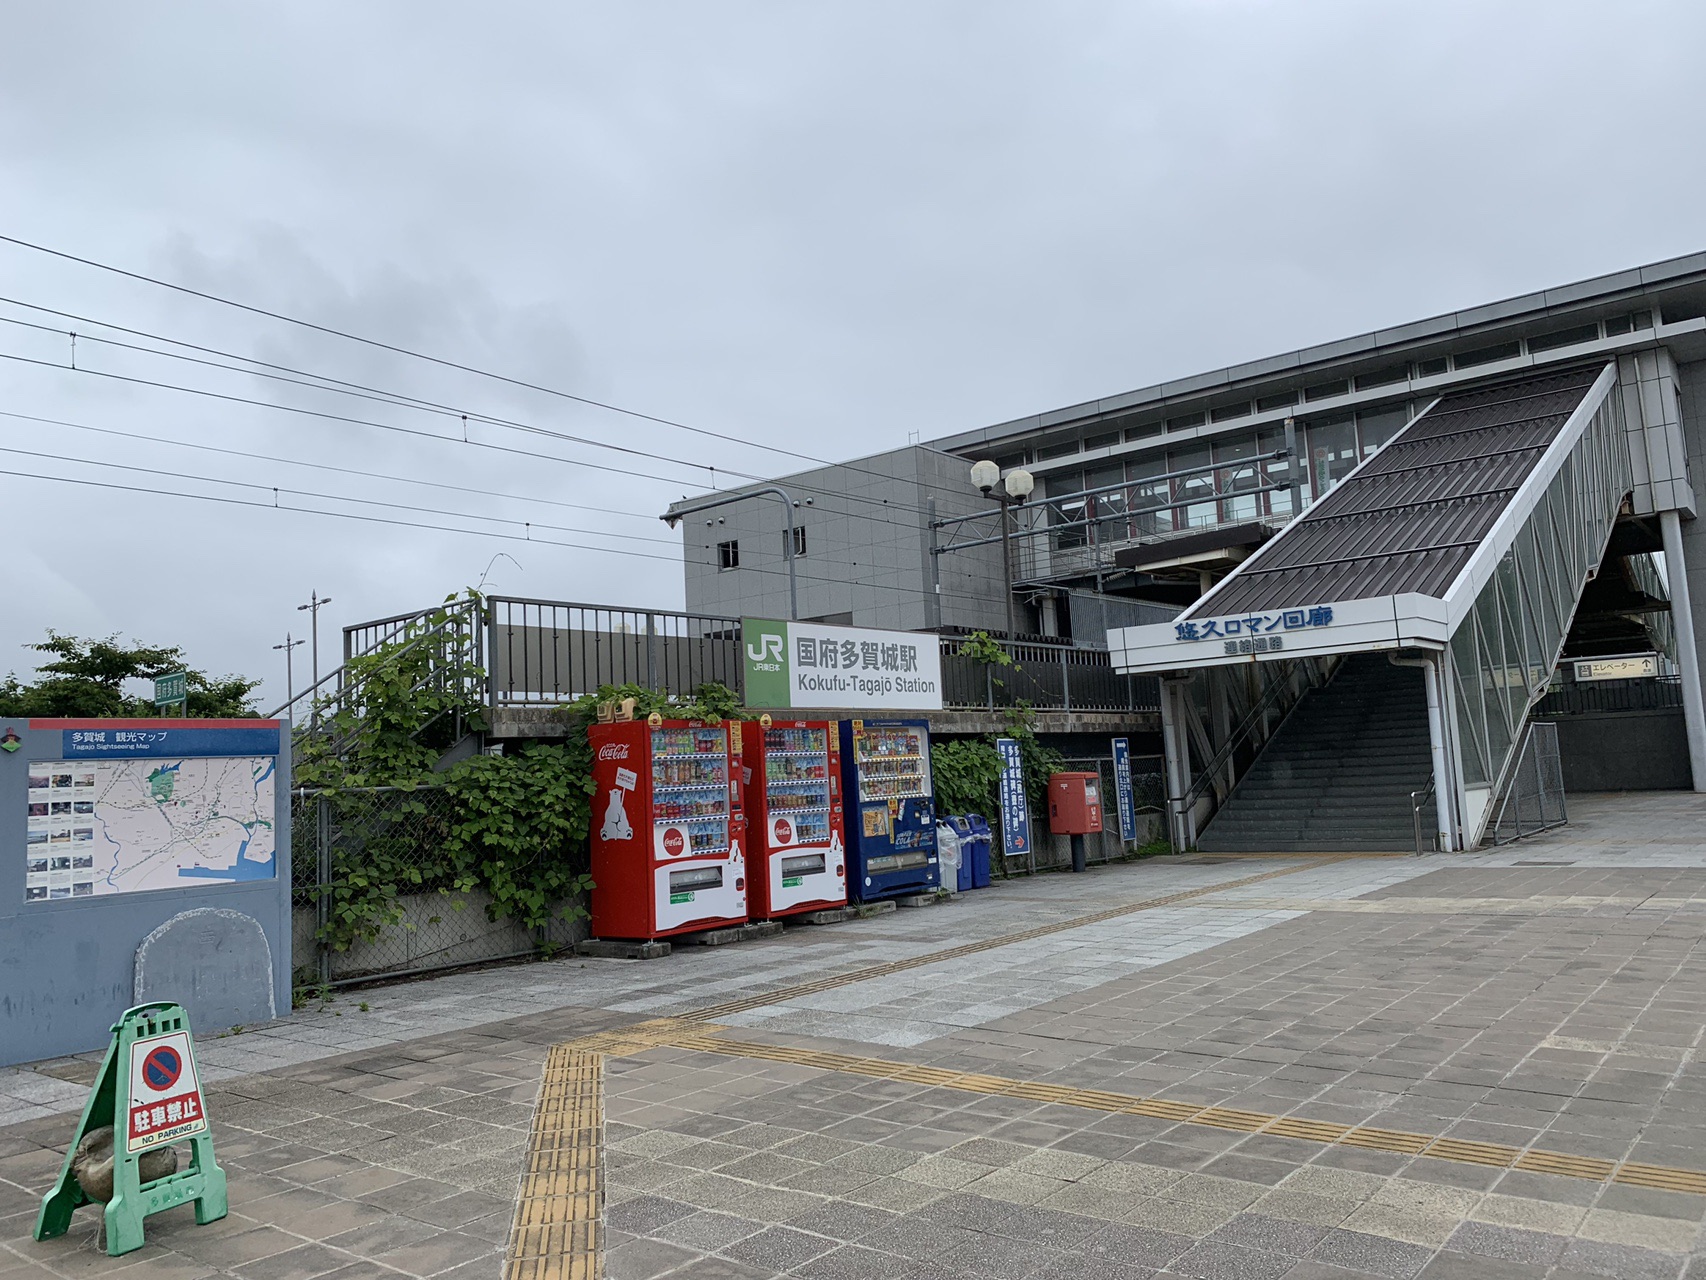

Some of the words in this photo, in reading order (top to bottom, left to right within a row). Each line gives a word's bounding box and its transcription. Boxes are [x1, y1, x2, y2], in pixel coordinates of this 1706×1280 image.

[1174, 606, 1334, 641] 悠久ロマン回廊
[747, 633, 784, 662] JR
[796, 636, 918, 673] 国府多賀城駅
[1224, 636, 1283, 654] 連絡通路
[753, 663, 780, 672] JR東日本
[1592, 662, 1635, 671] エレベーター
[156, 678, 184, 700] 国府多賀城
[798, 673, 892, 696] Kokufu-Tagajō
[895, 676, 935, 693] Station
[72, 731, 106, 743] 多賀城
[115, 731, 168, 743] 観光マップ
[72, 743, 95, 751] Tagajo
[134, 1097, 198, 1133] 駐車禁止
[142, 1135, 154, 1145] NO
[157, 1124, 192, 1140] PARKING
